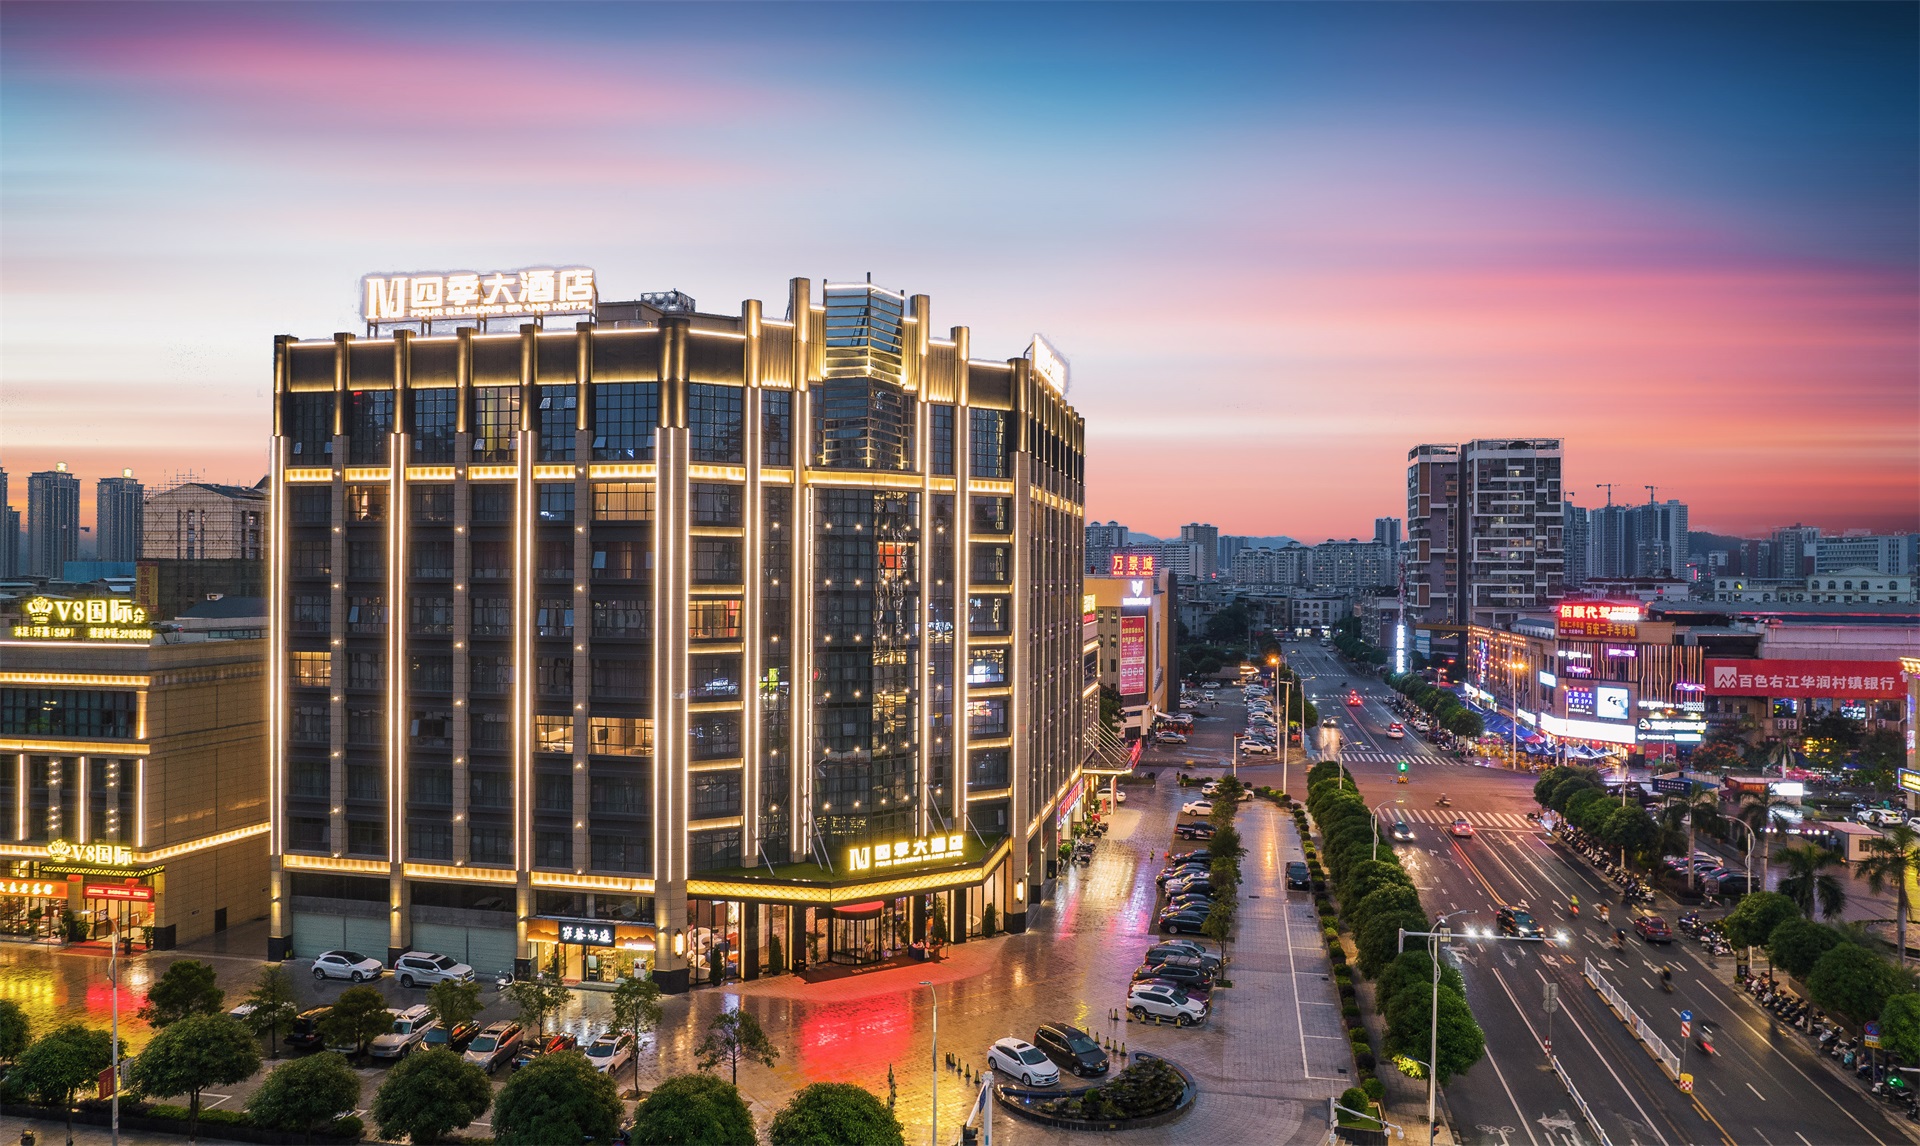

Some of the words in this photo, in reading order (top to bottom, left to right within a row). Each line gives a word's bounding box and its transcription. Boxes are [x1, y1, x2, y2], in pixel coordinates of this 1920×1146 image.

[411, 269, 593, 308] 四季大酒店
[1113, 555, 1153, 571] 万景城
[1586, 622, 1636, 637] 百宏二手车市场
[1739, 674, 1896, 691] 百色右江华润村镇银行
[71, 844, 133, 866] V8国际
